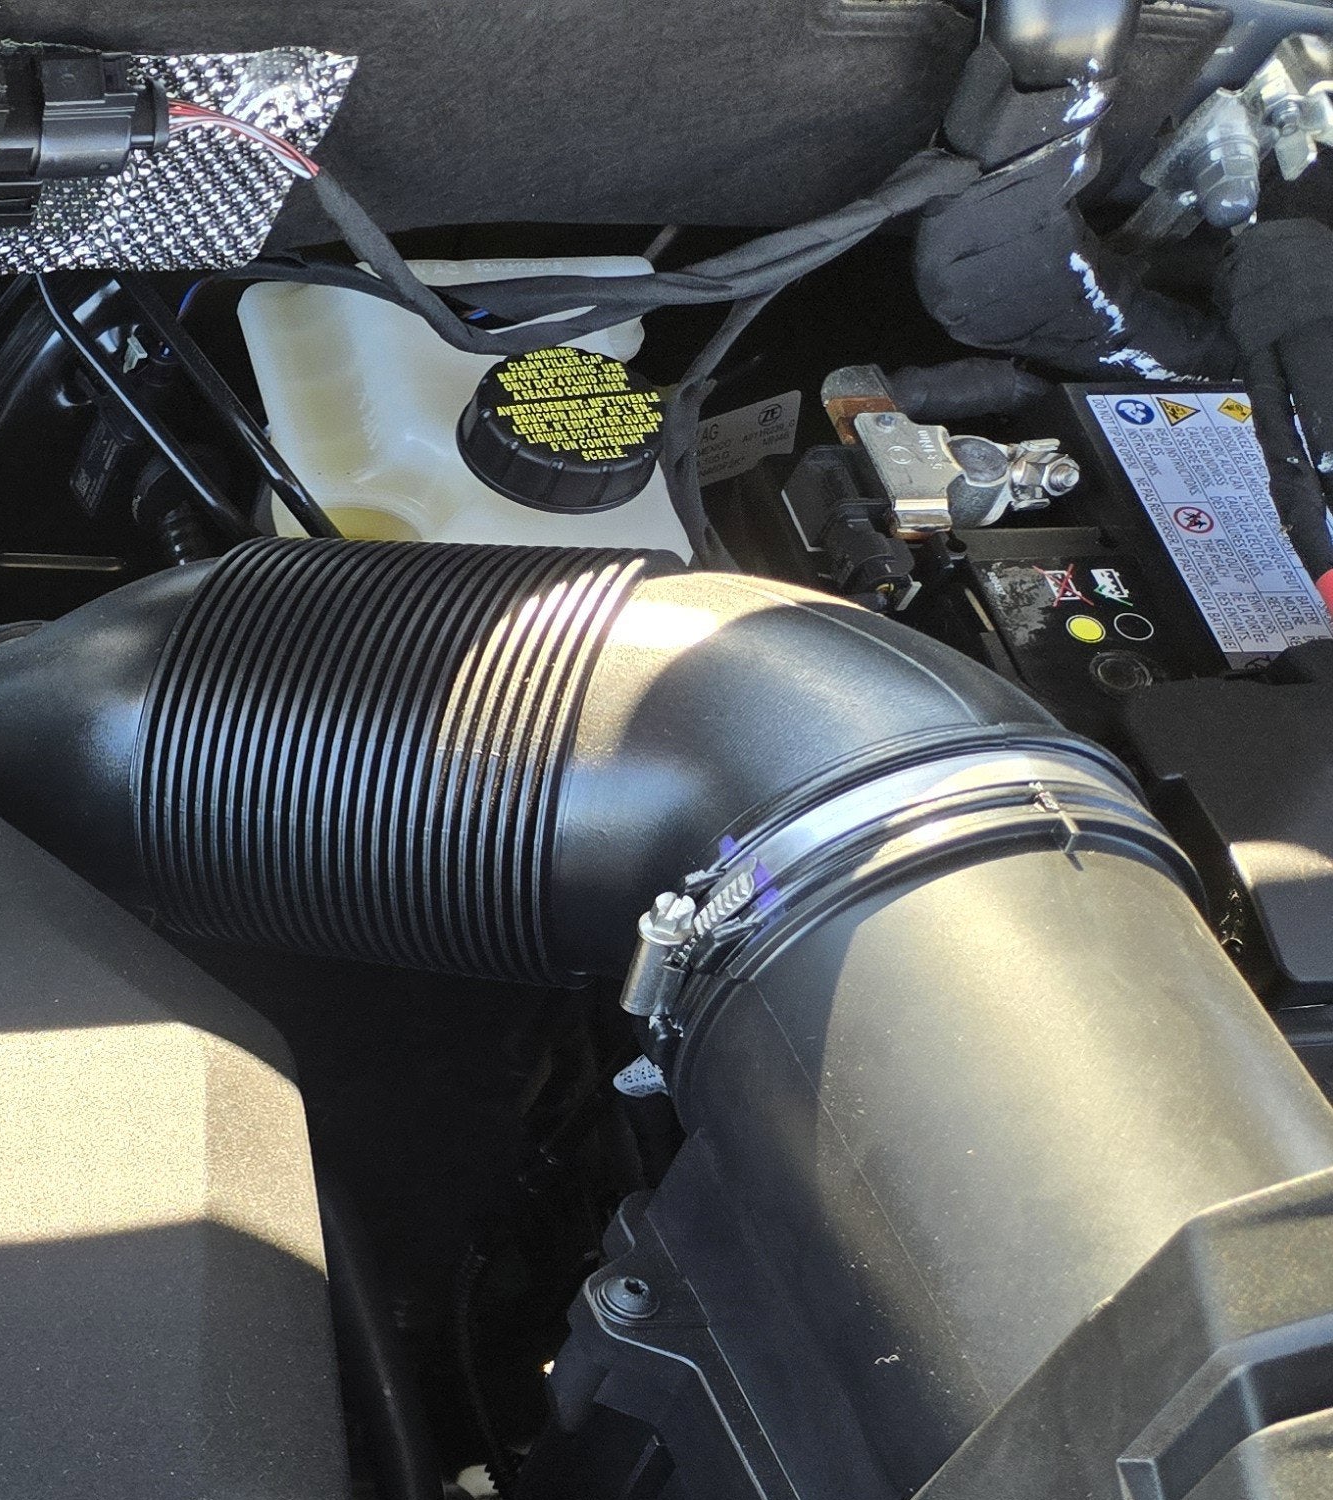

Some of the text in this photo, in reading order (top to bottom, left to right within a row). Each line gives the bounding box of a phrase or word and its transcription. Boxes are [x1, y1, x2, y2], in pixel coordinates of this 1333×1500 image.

[506, 354, 603, 371] CLEAN FILLER CAP
[524, 347, 579, 360] WARNING:
[496, 362, 625, 383] BEFORE REMOVING. USE
[503, 371, 628, 392] ONLY DOT 4 FLUID FROM
[512, 382, 630, 401] A SEALED CONTAINER.
[496, 391, 660, 417] AVERTISSEMENT: NETTOYER LE
[1091, 399, 1108, 409] DO
[512, 411, 568, 425] BOUCHON
[568, 407, 603, 420] AVANT
[606, 405, 622, 416] DE
[512, 411, 663, 435] LEVER. N'EMPLOYER QUE DU
[1097, 409, 1116, 424] NOT
[524, 431, 570, 444] LIQUIDE
[598, 422, 659, 437] PROVENANT
[1105, 425, 1122, 437] TIP
[1152, 427, 1174, 446] READ
[1169, 426, 1186, 438] OR
[549, 433, 645, 452] D'UN CONTENANT
[1112, 437, 1129, 449] OR
[1138, 428, 1165, 456] LIRE LES
[1176, 438, 1201, 464] SEVERE
[1214, 425, 1248, 464] CONSULTEZ
[1238, 465, 1254, 476] UN
[1183, 426, 1229, 486] CAUSE BLINDNESS
[1198, 425, 1245, 489] SULFURIC ACID CAN
[1133, 476, 1150, 487] NE
[1139, 488, 1159, 502] PAS
[1208, 496, 1227, 510] DES
[1221, 495, 1249, 523] CAUSER
[1238, 523, 1255, 534] LA
[1258, 559, 1275, 570] OU
[1237, 495, 1302, 589] L'ACIDE SULFURIQUE PEUT
[1170, 546, 1188, 558] NE
[1183, 538, 1201, 549] OF
[1177, 558, 1196, 572] PAS
[1198, 538, 1232, 578] THE REACH
[1212, 537, 1250, 584] KEEP OUT OF
[1185, 573, 1211, 601] OUVRIR
[1228, 591, 1246, 602] DE
[1200, 601, 1217, 612] LA
[1213, 591, 1233, 606] DES
[1235, 603, 1252, 614] LA
[1243, 591, 1279, 634] TENIR HORS
[1278, 595, 1307, 625] MUST BE
[1293, 595, 1322, 626] BATTERY
